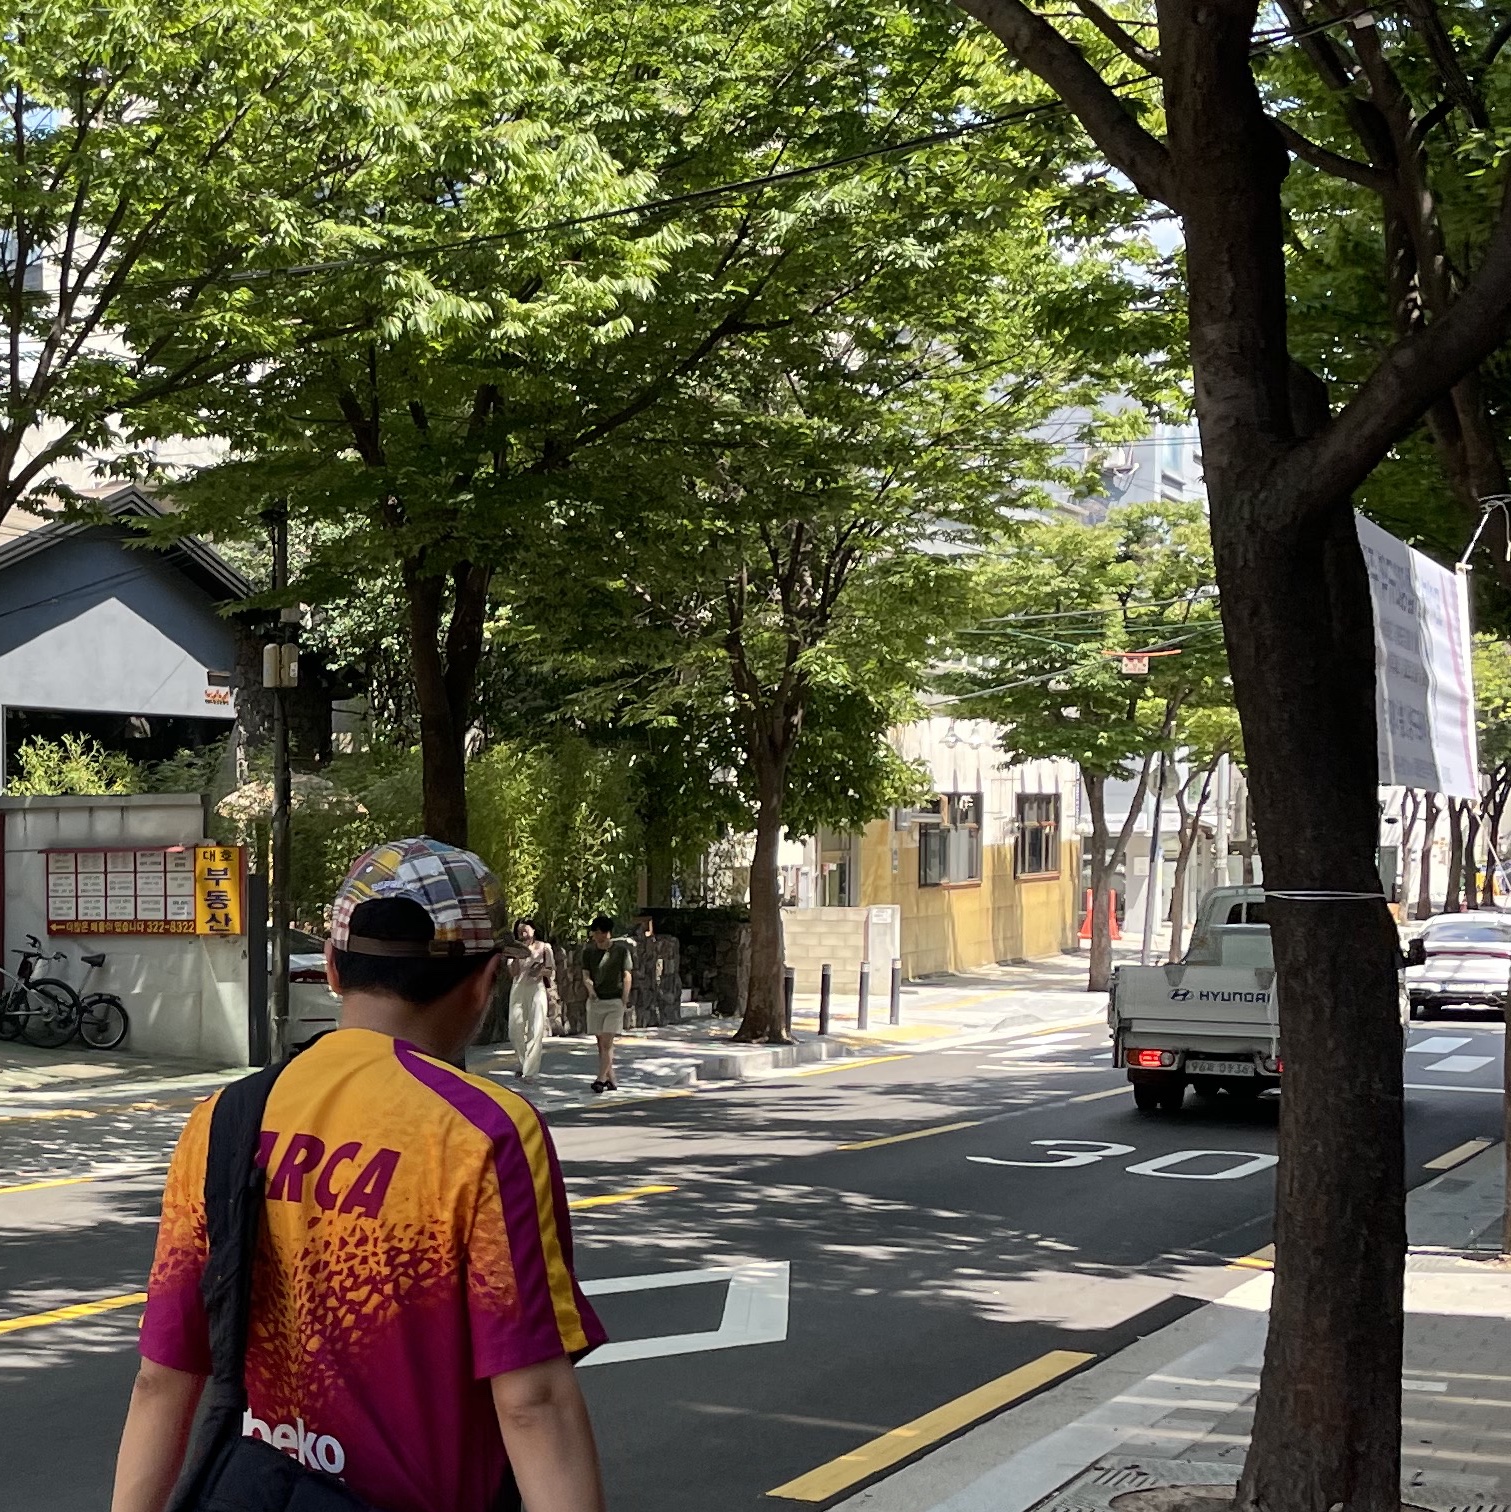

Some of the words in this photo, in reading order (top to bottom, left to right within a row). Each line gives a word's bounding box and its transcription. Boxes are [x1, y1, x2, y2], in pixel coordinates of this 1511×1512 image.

[202, 849, 234, 862] 대호
[203, 867, 232, 932] 부동산
[147, 920, 195, 932] 322-8322
[965, 1139, 1280, 1180] 30
